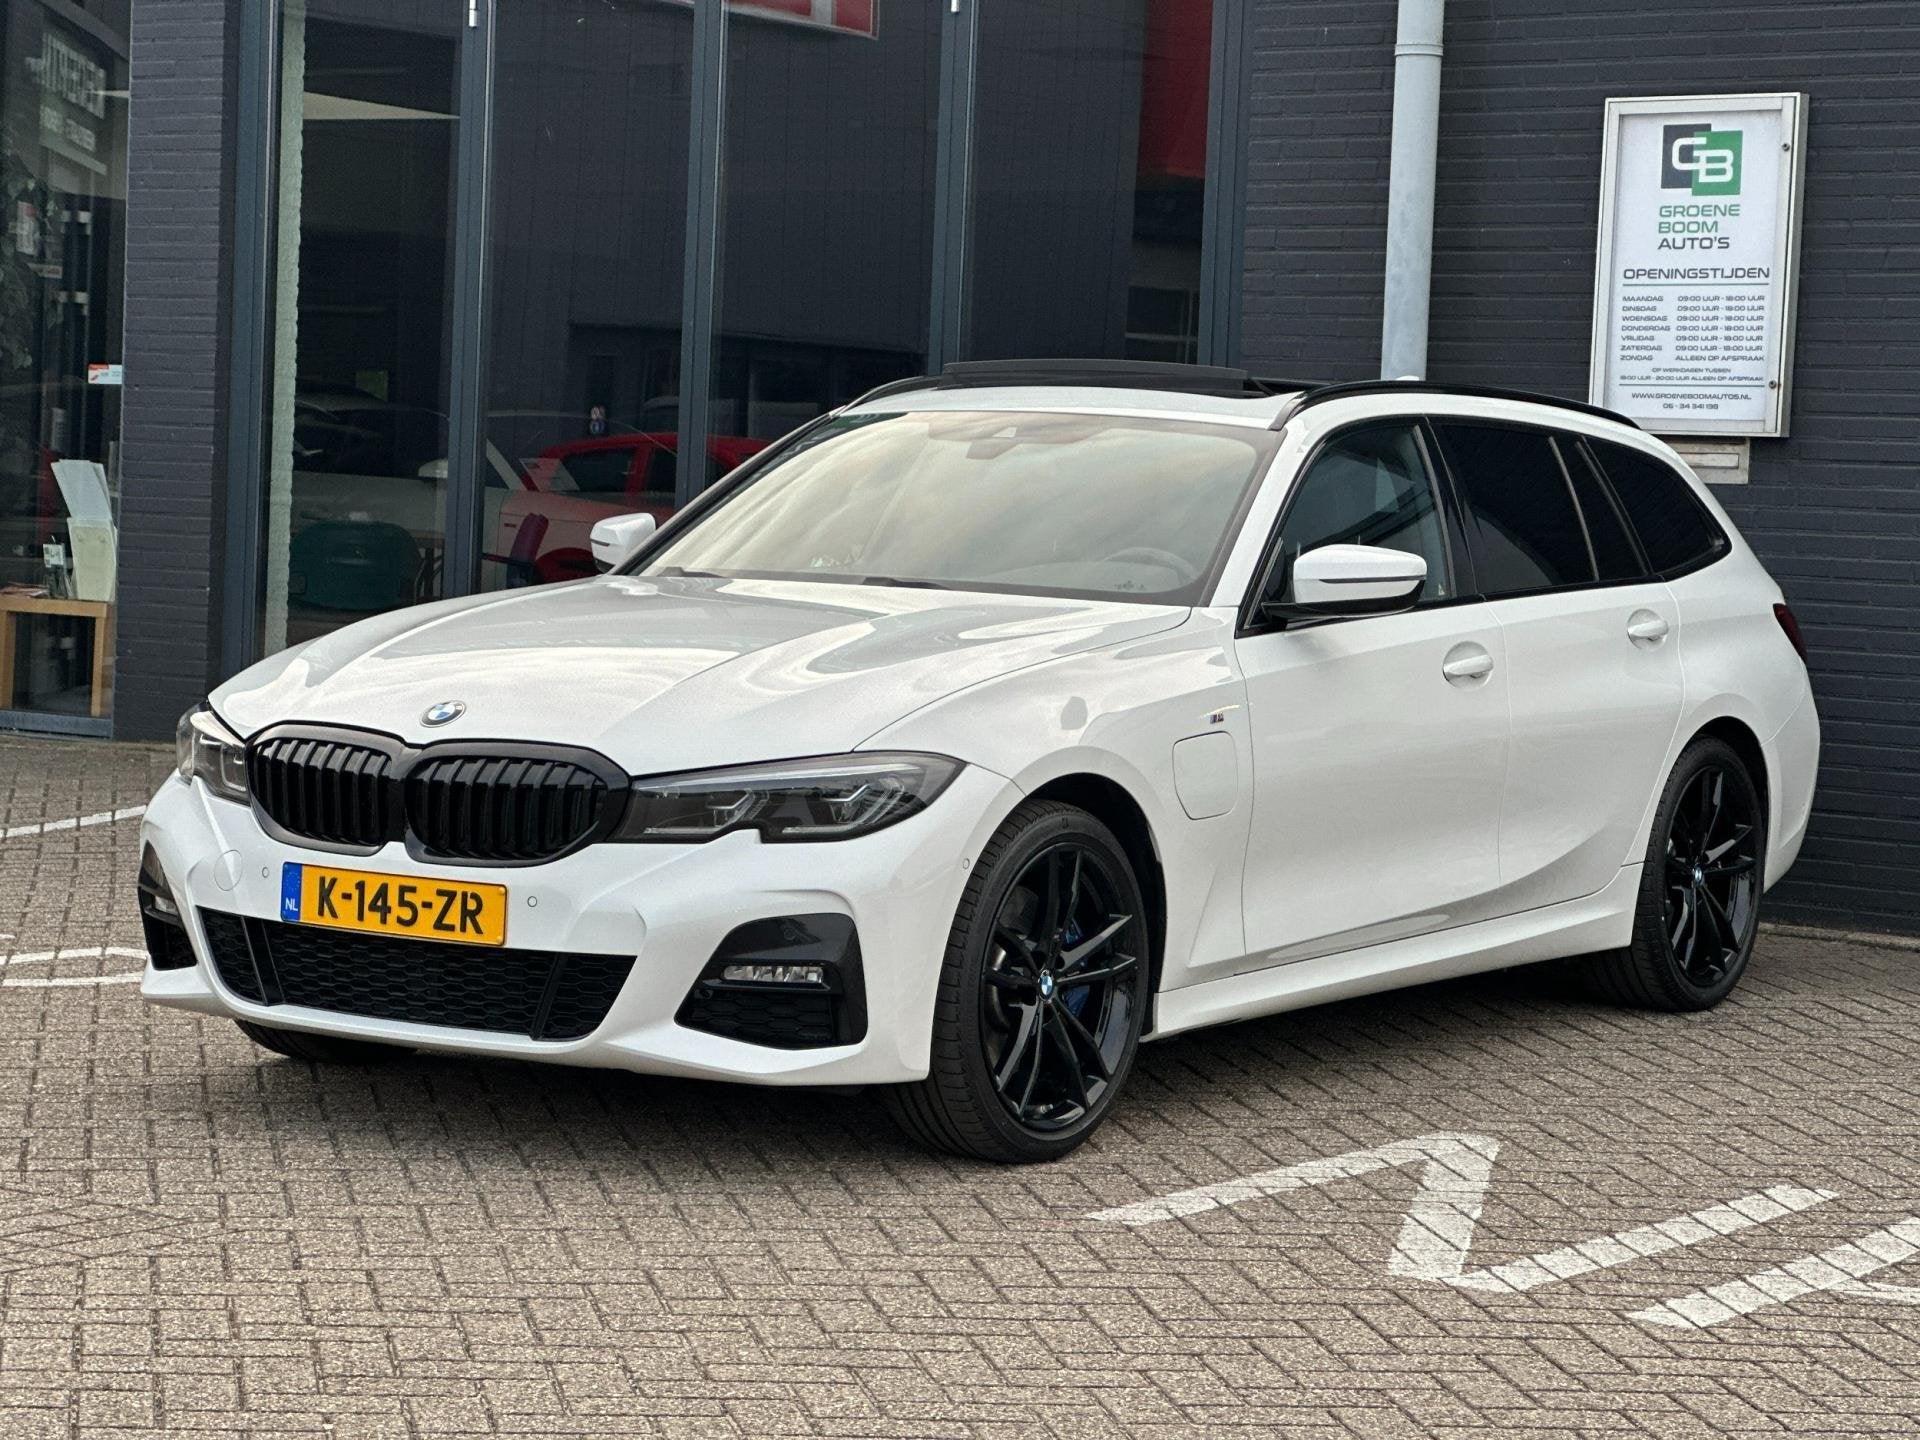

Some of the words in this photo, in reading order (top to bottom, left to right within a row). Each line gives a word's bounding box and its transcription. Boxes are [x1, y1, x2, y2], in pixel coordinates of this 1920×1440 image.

[1659, 204, 1741, 218] GROENE
[1658, 220, 1719, 234] BOOM
[1657, 236, 1730, 250] AUTO'S
[1623, 267, 1770, 280] OPENINGSTIJDEN
[285, 898, 299, 912] NL
[317, 875, 484, 935] K-145-ZR
